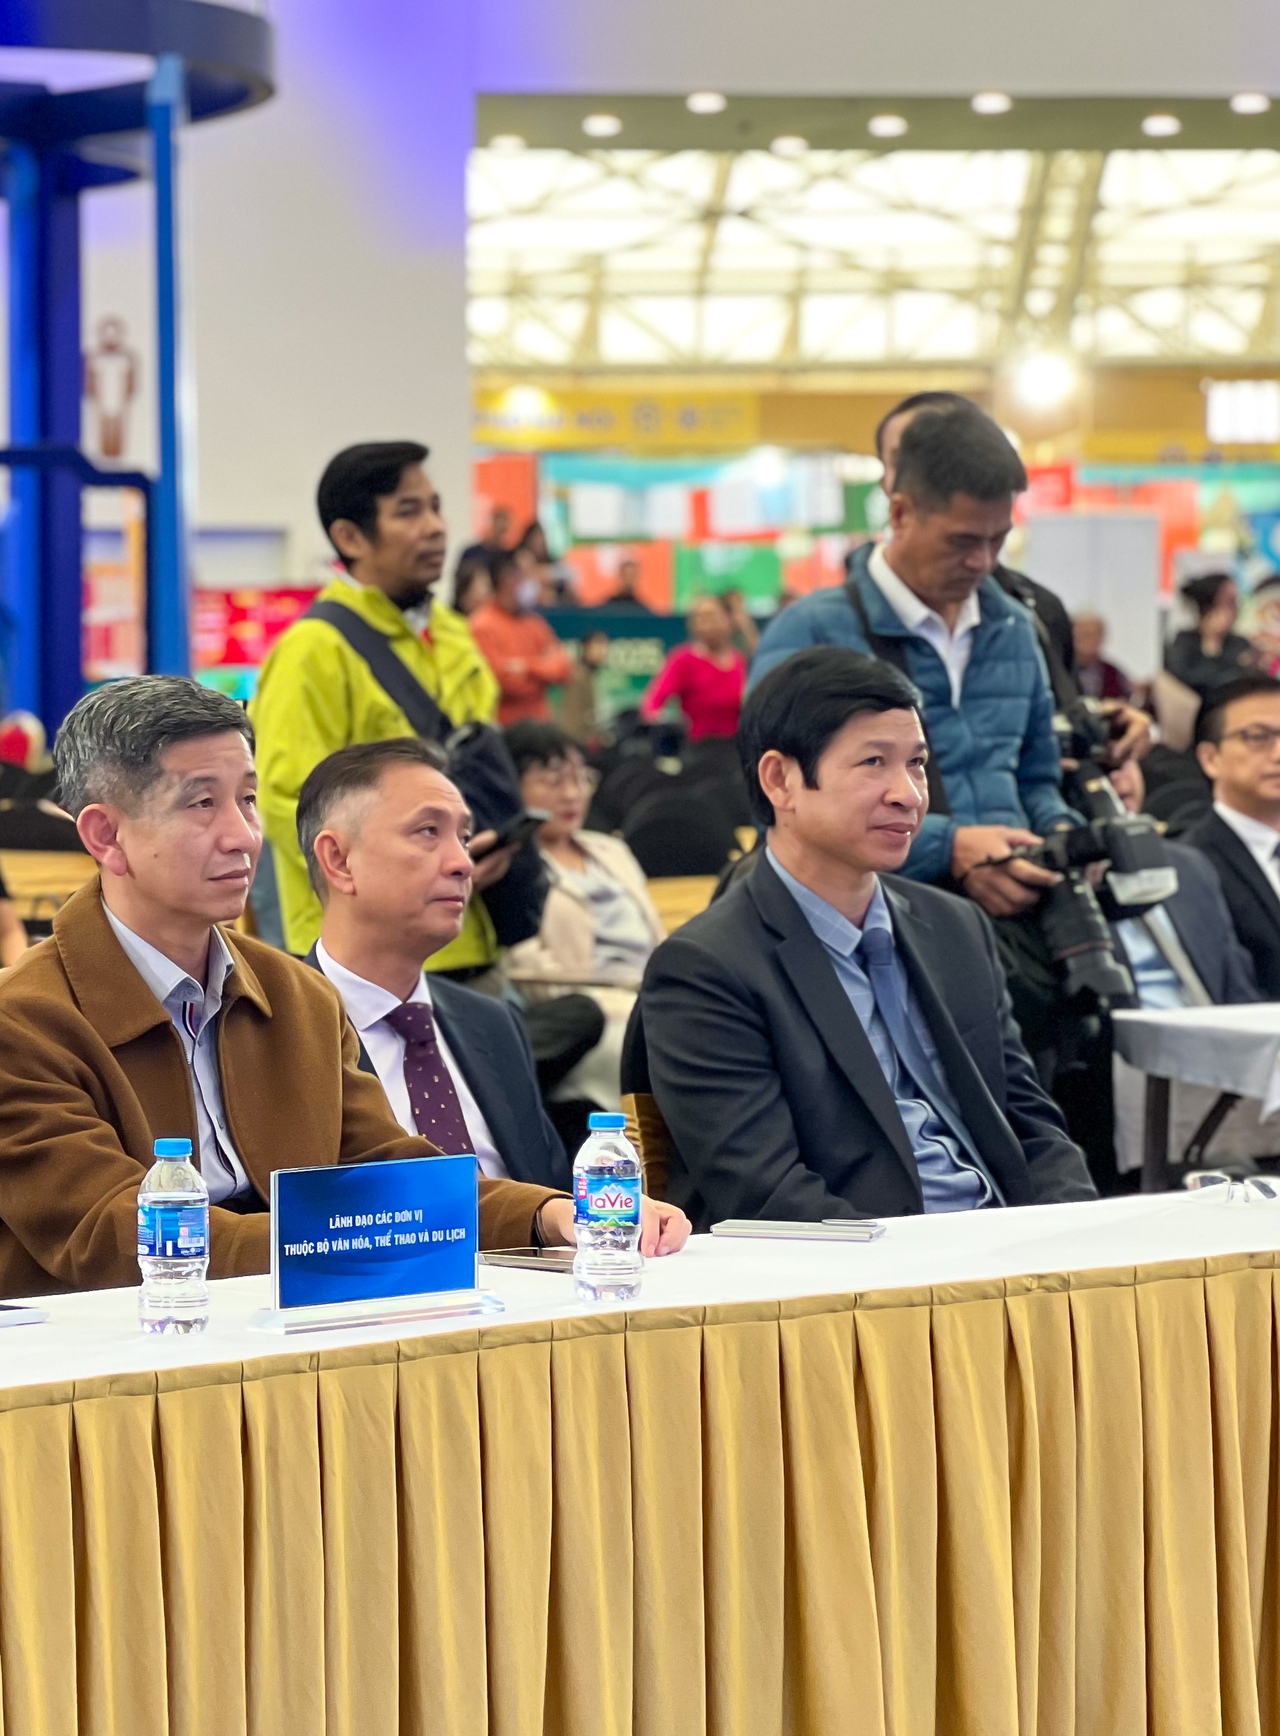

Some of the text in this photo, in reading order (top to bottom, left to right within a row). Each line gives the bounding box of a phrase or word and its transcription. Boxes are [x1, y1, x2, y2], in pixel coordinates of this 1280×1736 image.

[590, 1192, 633, 1209] laVie
[329, 1209, 423, 1230] LÃNH ĐẠO CÁC ĐƠN VỊ
[284, 1227, 466, 1257] THUỘC BỘ VĂN HÓA, THỂ THAO VÀ DU LỊCH
